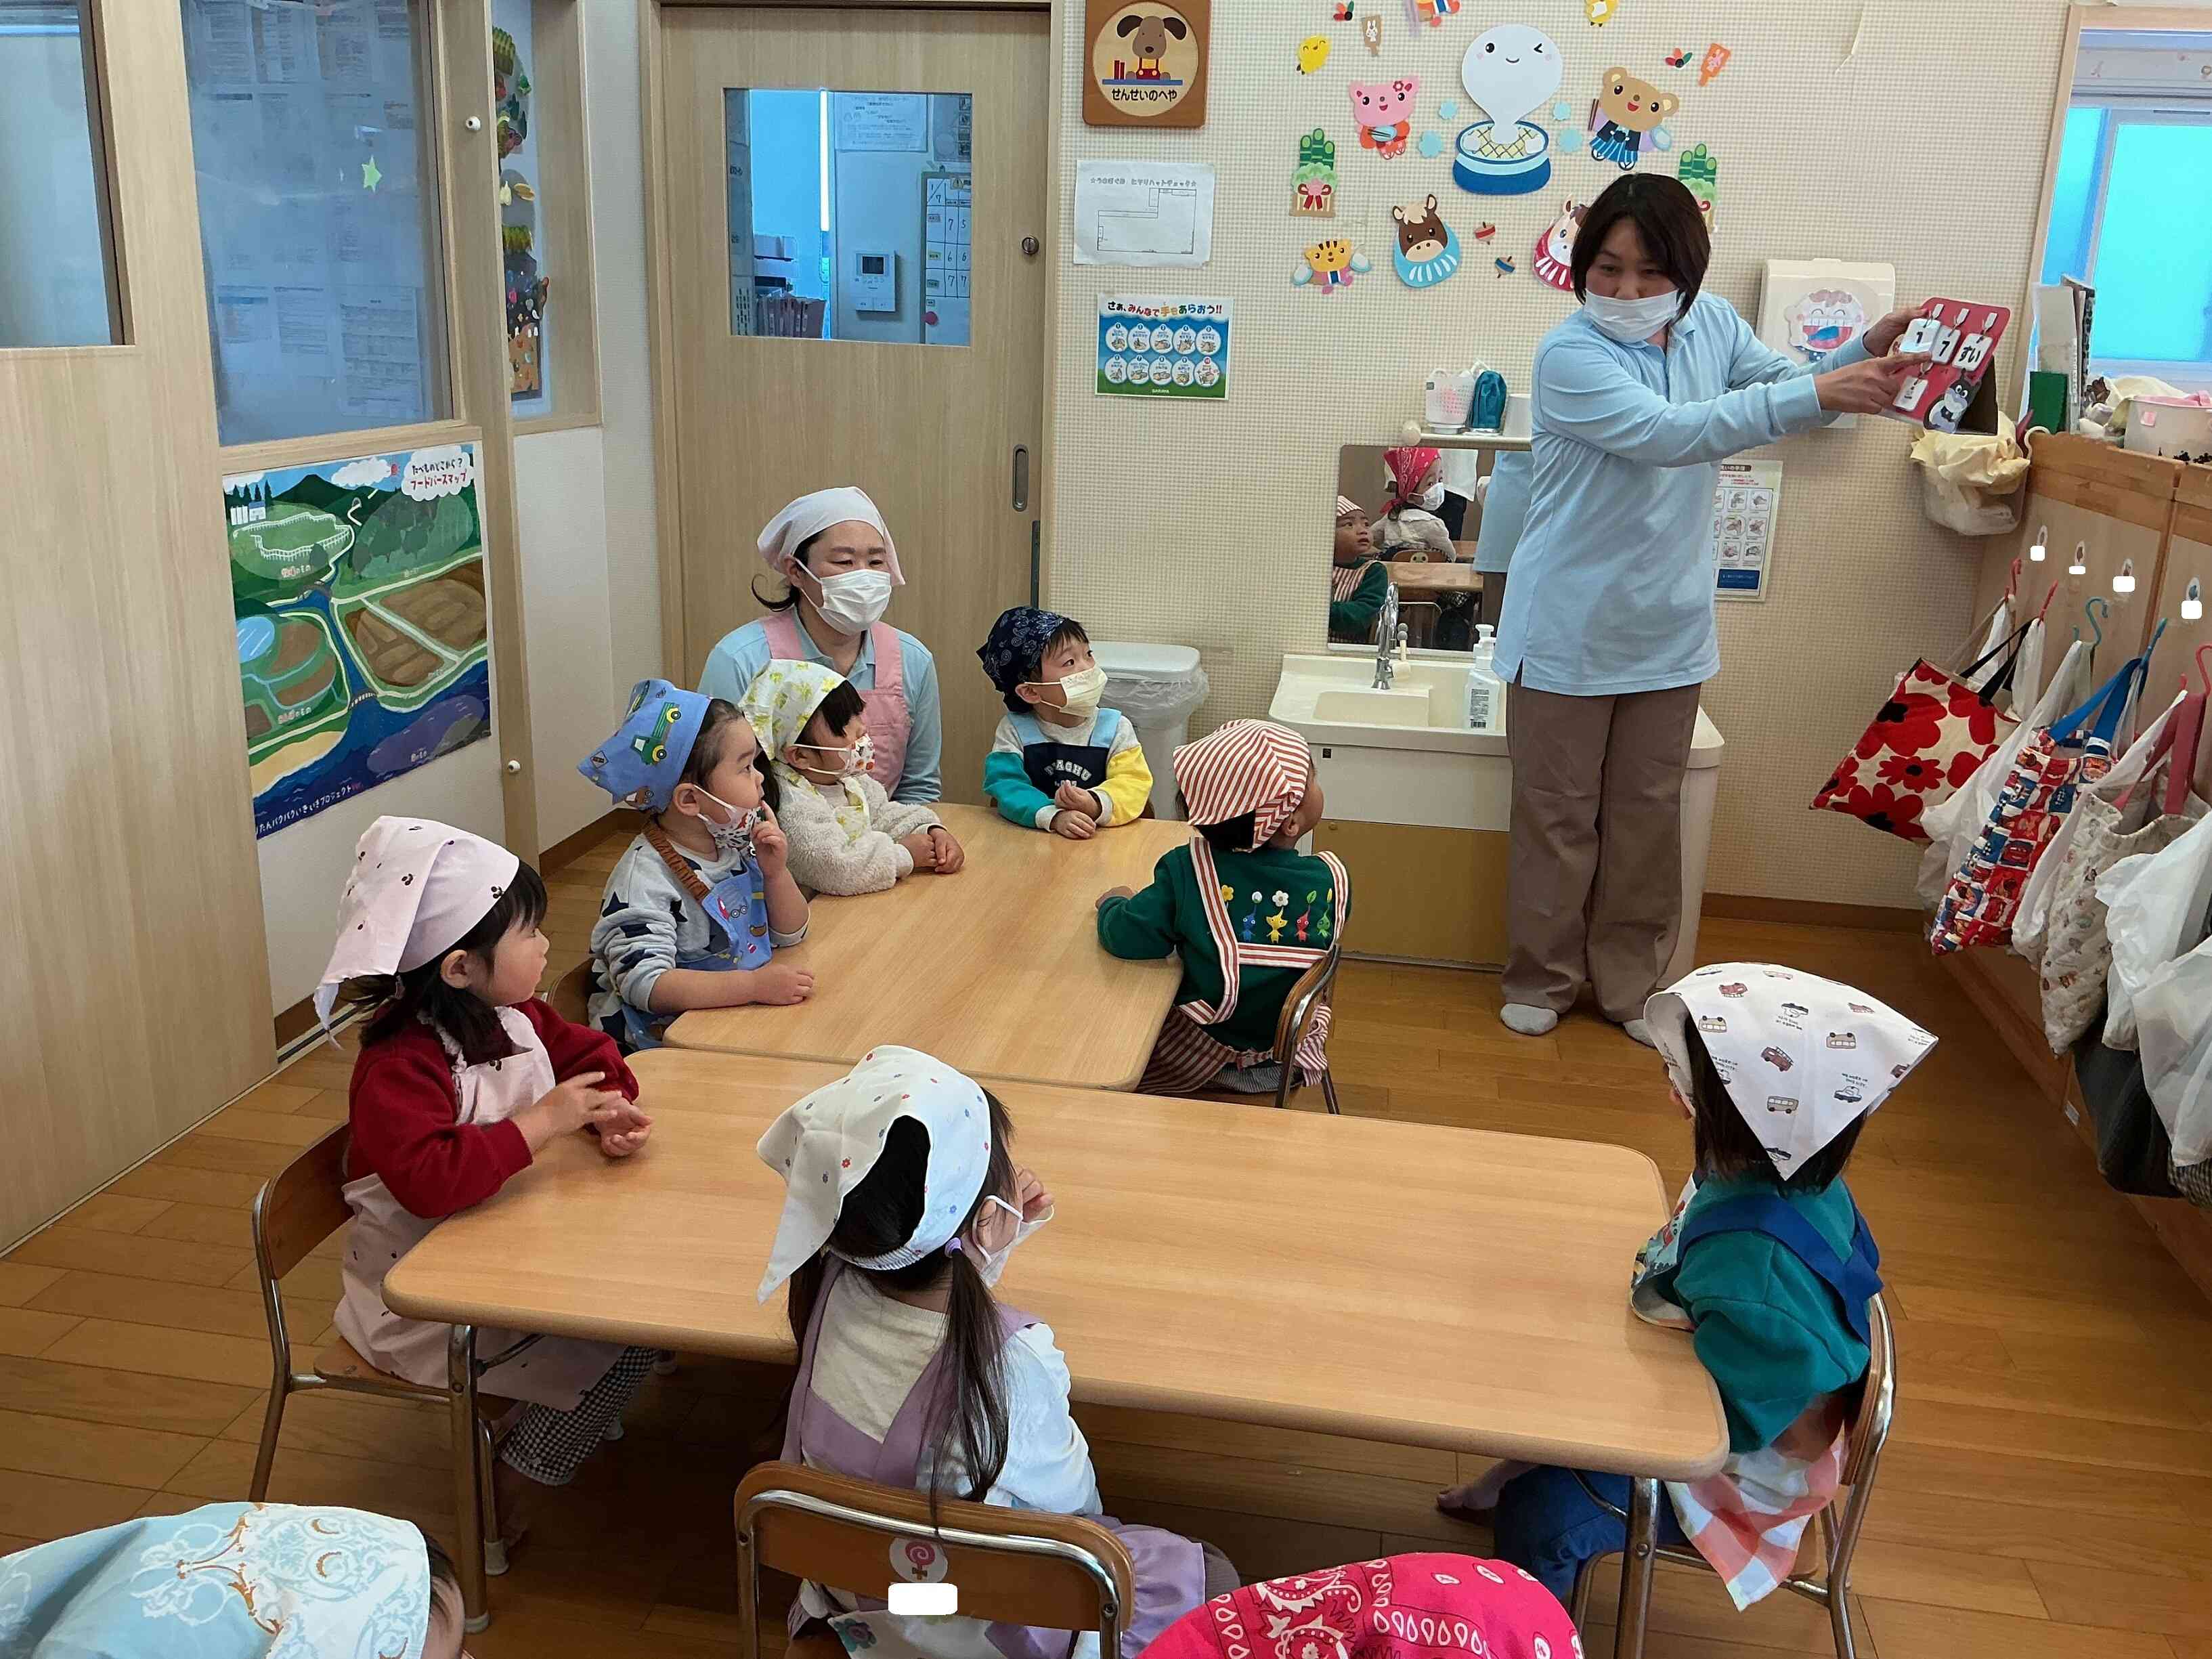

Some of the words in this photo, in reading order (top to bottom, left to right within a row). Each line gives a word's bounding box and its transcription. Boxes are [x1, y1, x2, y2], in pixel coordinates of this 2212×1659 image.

[1111, 88, 1177, 102] せんせいのへや
[948, 219, 954, 231] 7
[961, 251, 967, 262] 6
[948, 275, 955, 287] 7
[961, 275, 967, 287] 7
[1916, 331, 1924, 344] 1
[1939, 341, 1950, 357] 7
[1959, 345, 1981, 363] すい
